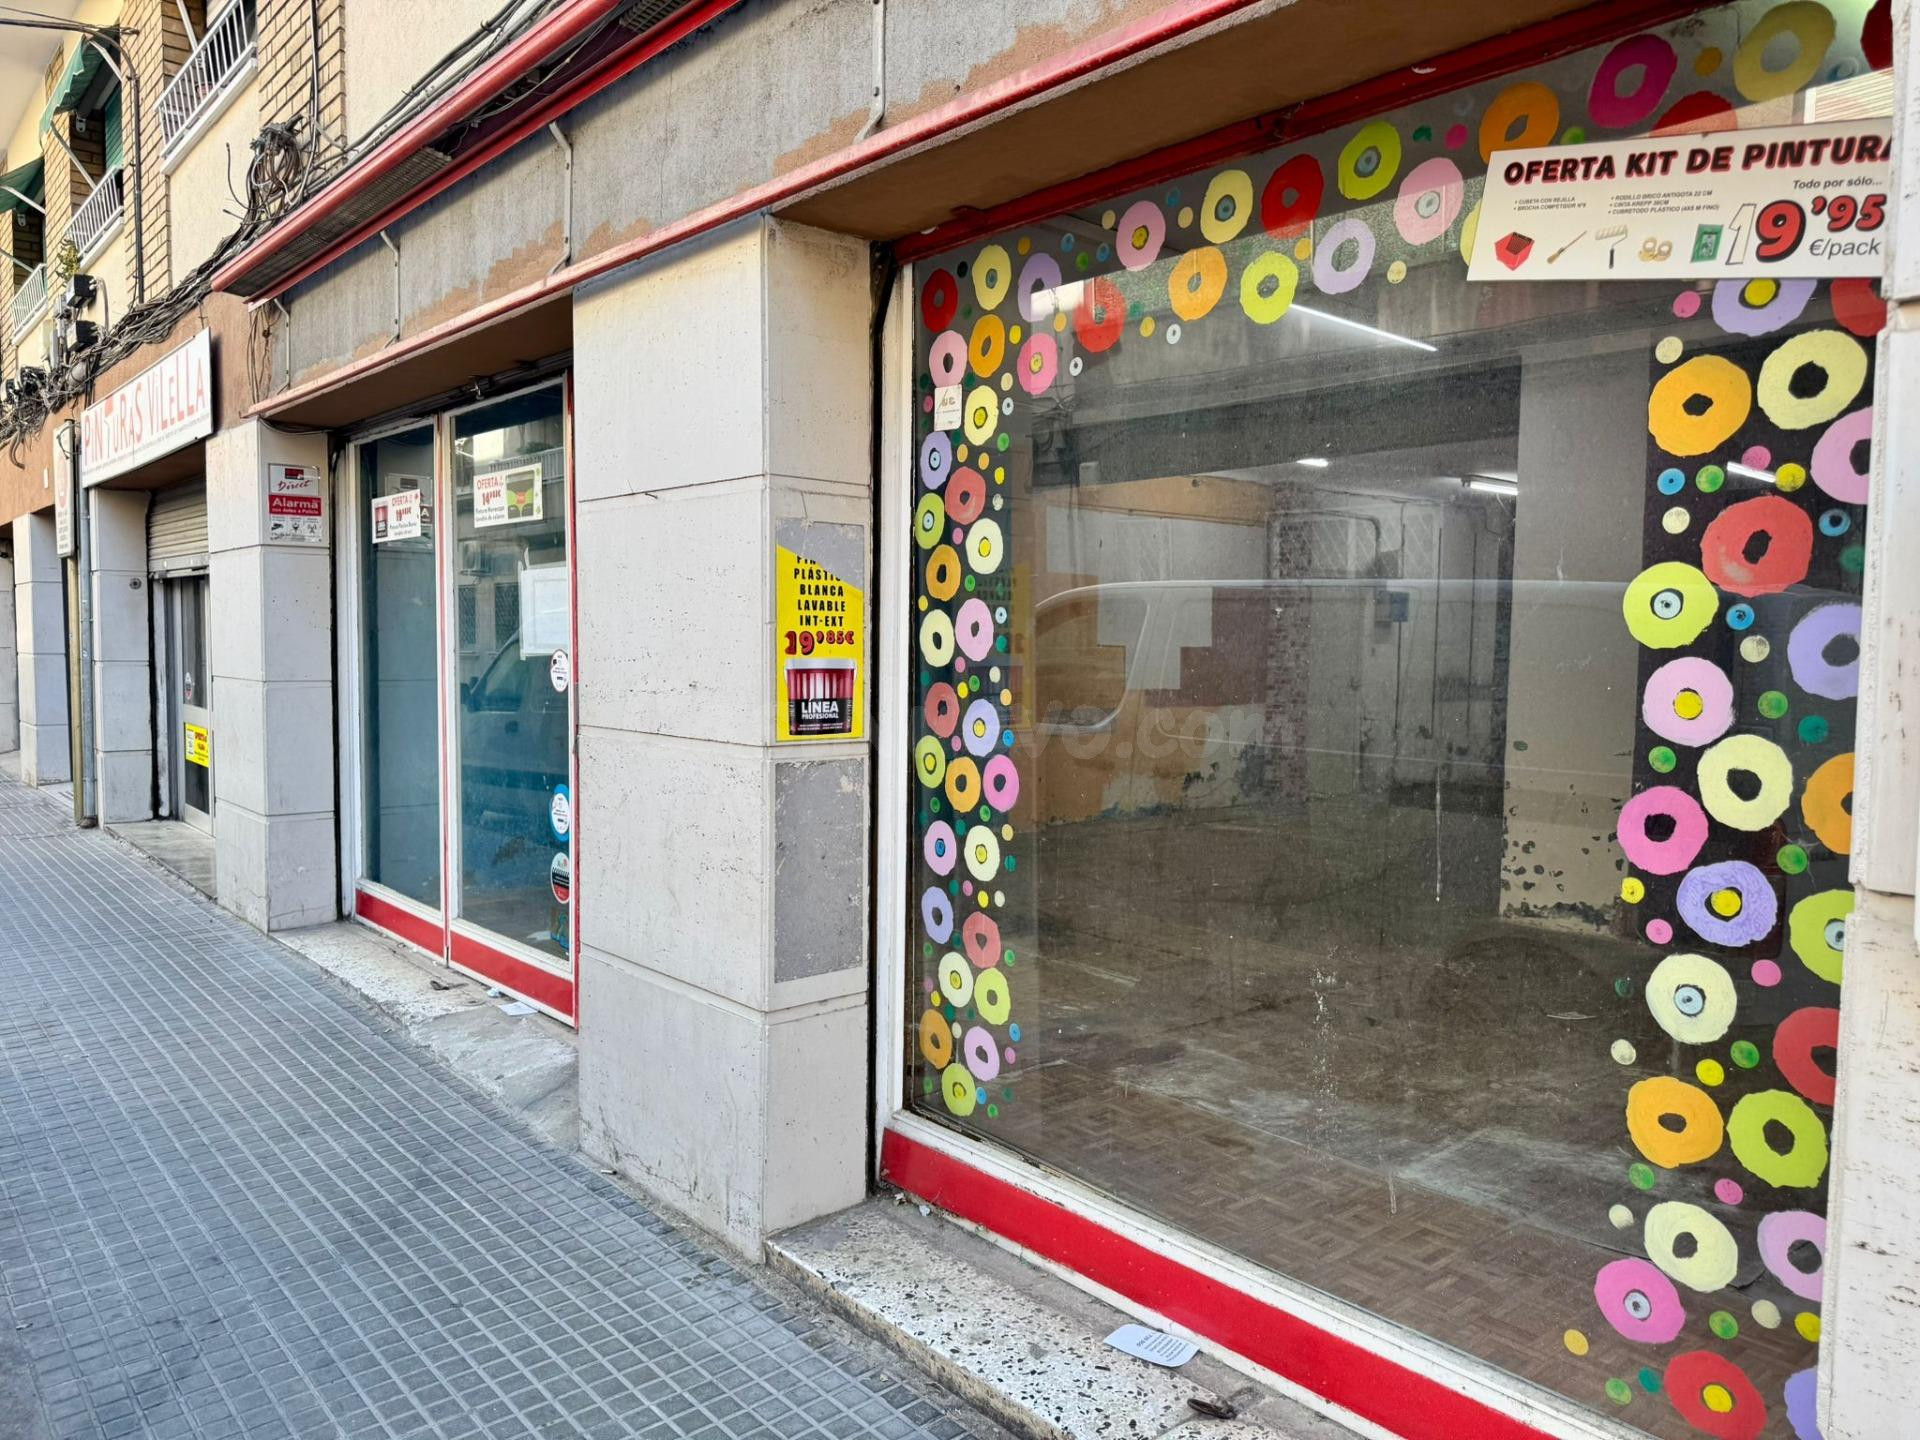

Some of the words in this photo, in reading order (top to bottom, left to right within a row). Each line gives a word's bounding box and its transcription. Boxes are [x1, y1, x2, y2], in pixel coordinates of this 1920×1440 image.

[1504, 152, 1616, 185] OFERTA
[1625, 149, 1678, 179] KIT
[1685, 145, 1734, 173] DE
[1793, 179, 1821, 189] Todo
[1822, 180, 1844, 190] por
[1846, 176, 1883, 187] sólo...
[1808, 237, 1882, 261] €/pack
[272, 497, 319, 509] Alarma
[794, 567, 841, 582] PLÁSTI
[799, 584, 844, 597] BLANCA
[797, 599, 846, 612] LAVABLE
[799, 615, 844, 627] INT-EXT
[801, 698, 840, 714] LÍNEA
[801, 712, 840, 720] PROFESIONAL
